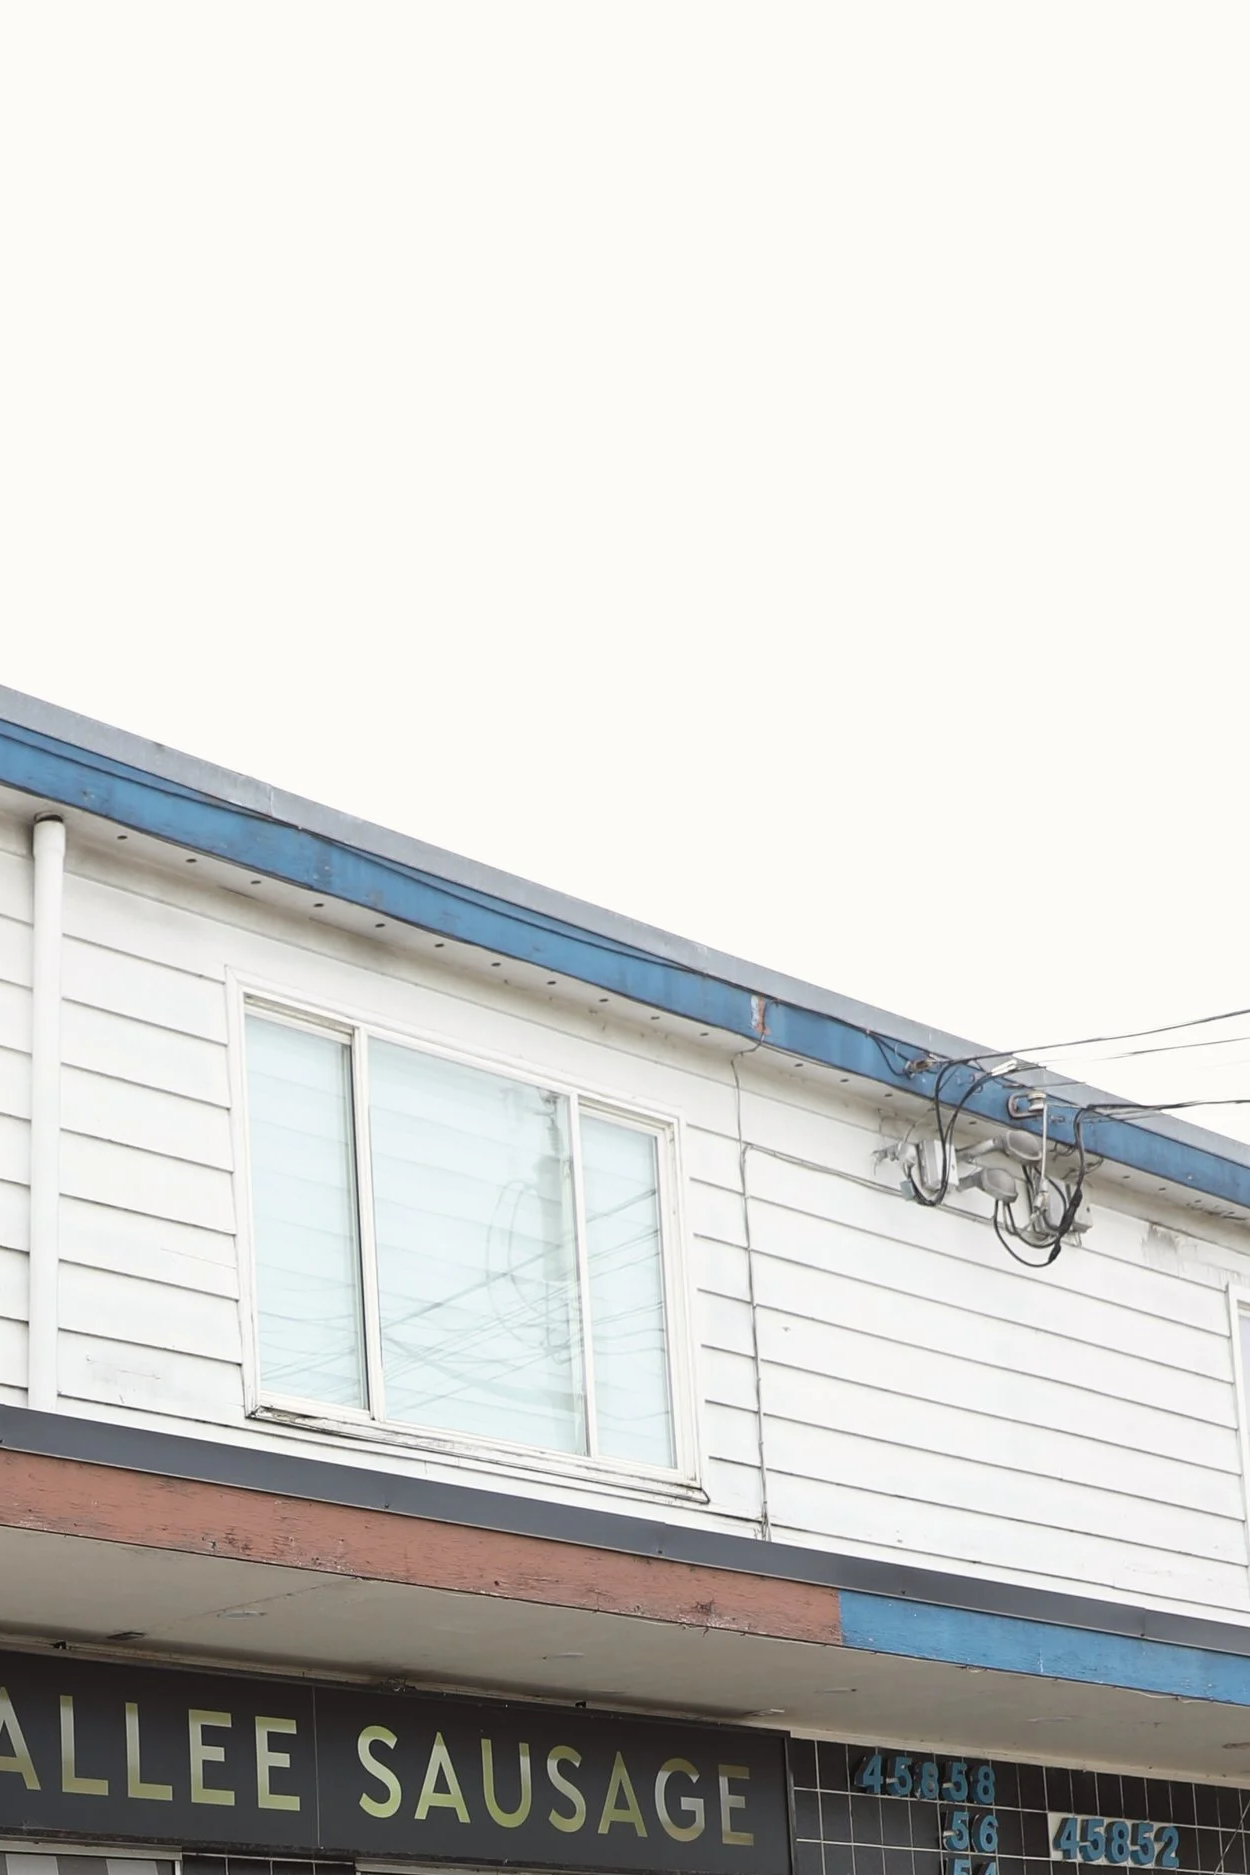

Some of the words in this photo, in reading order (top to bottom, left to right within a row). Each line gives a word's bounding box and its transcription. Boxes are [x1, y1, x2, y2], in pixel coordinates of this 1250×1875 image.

[356, 1724, 755, 1847] SAUSAGE
[854, 1753, 997, 1805] 45858
[944, 1810, 999, 1853] 56
[1053, 1815, 1180, 1869] 45852
